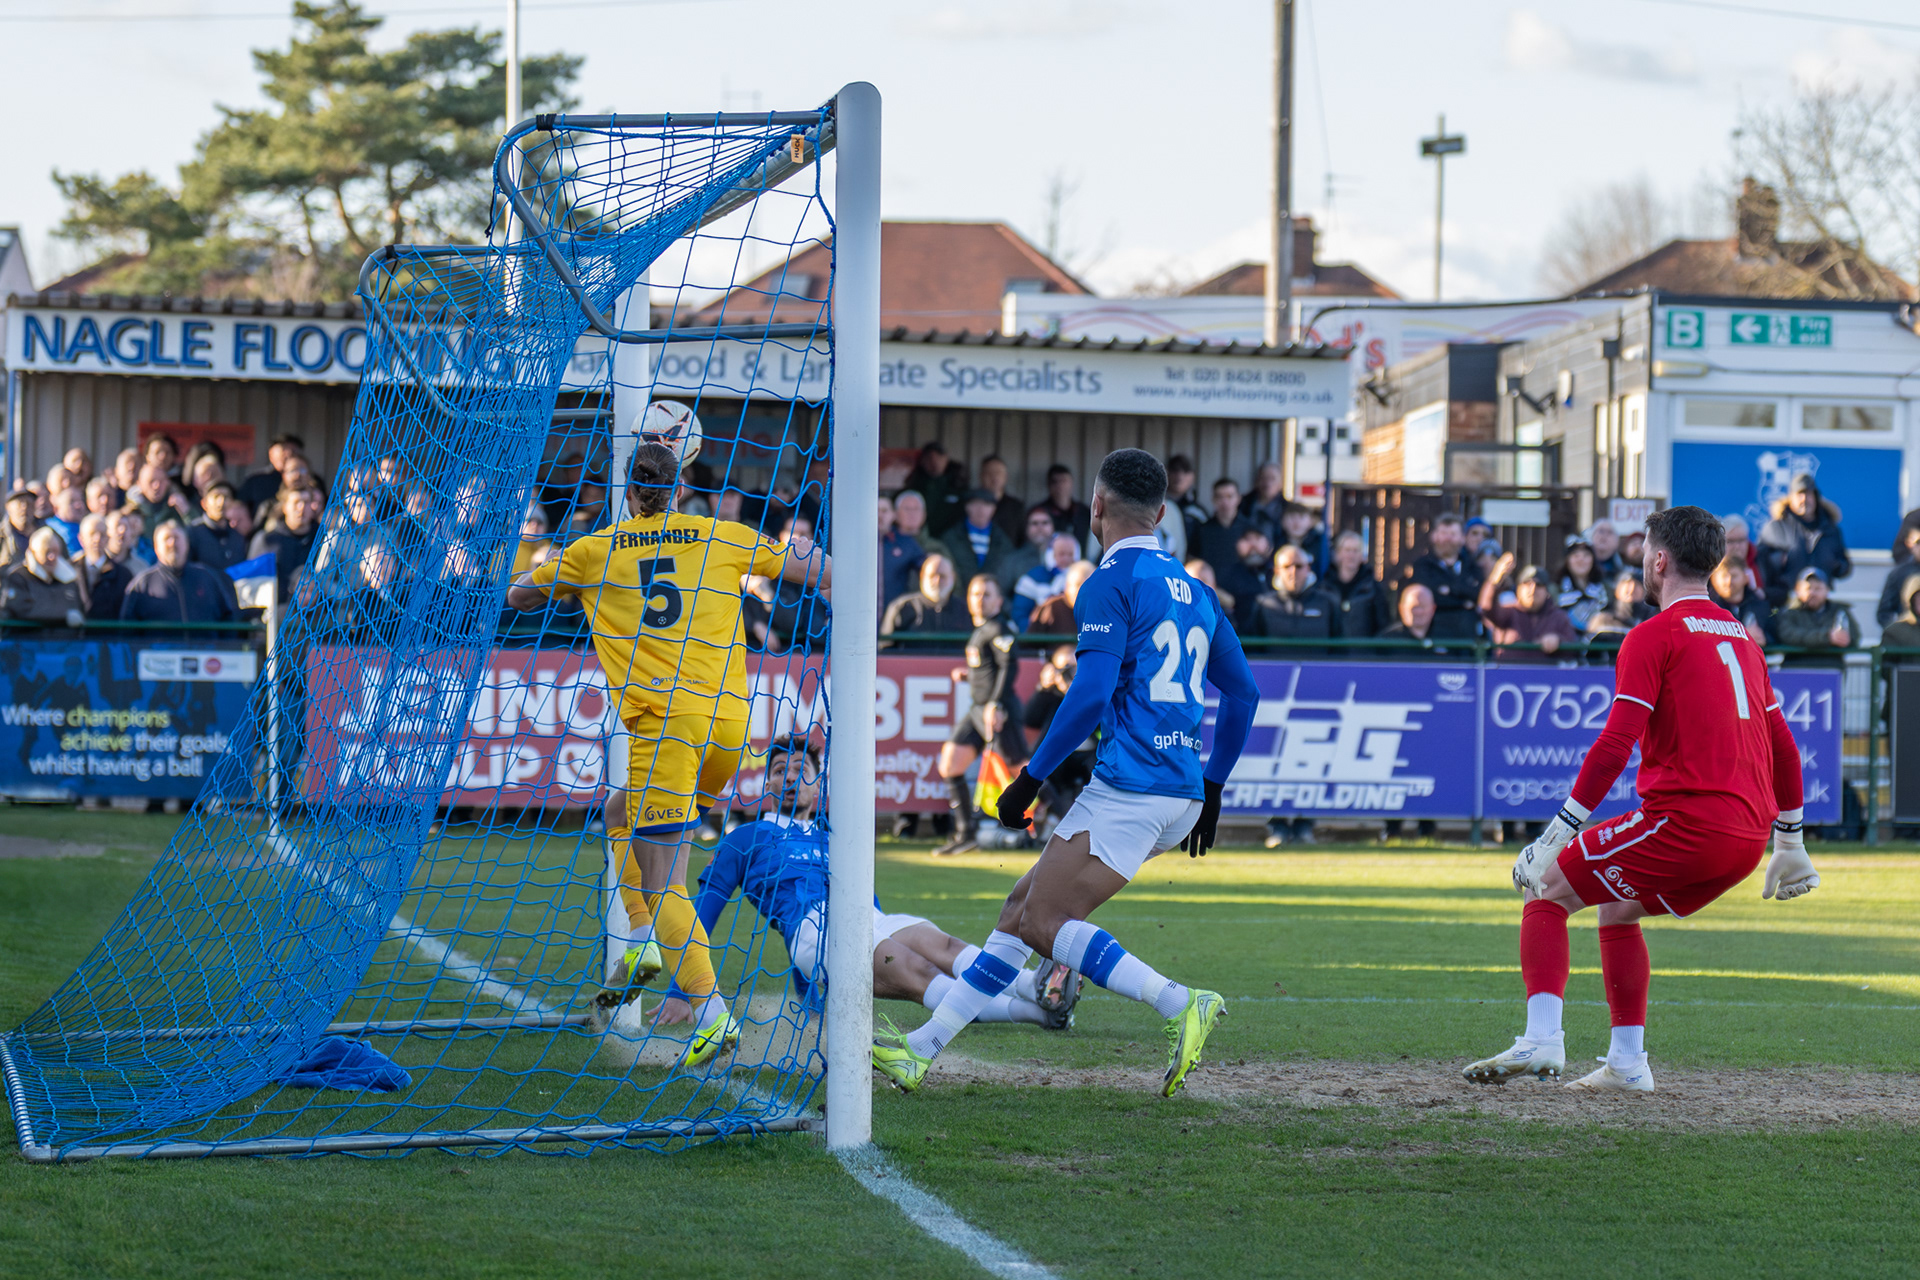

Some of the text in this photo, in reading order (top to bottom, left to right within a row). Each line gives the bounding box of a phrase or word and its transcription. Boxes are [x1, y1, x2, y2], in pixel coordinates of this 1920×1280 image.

[1670, 313, 1700, 345] B
[1800, 318, 1828, 331] Fire
[23, 314, 213, 370] NAGLE
[939, 357, 1103, 397] Specialists
[612, 528, 700, 552] FERNANDEZ
[637, 555, 684, 630] 5
[1150, 619, 1210, 707] 22
[1716, 640, 1751, 720] 1
[1, 704, 171, 732] Where champions
[60, 729, 133, 752] achieve
[134, 731, 178, 753] their
[28, 754, 204, 782] whilst having a ball
[1221, 782, 1407, 811] CAFFOLDING
